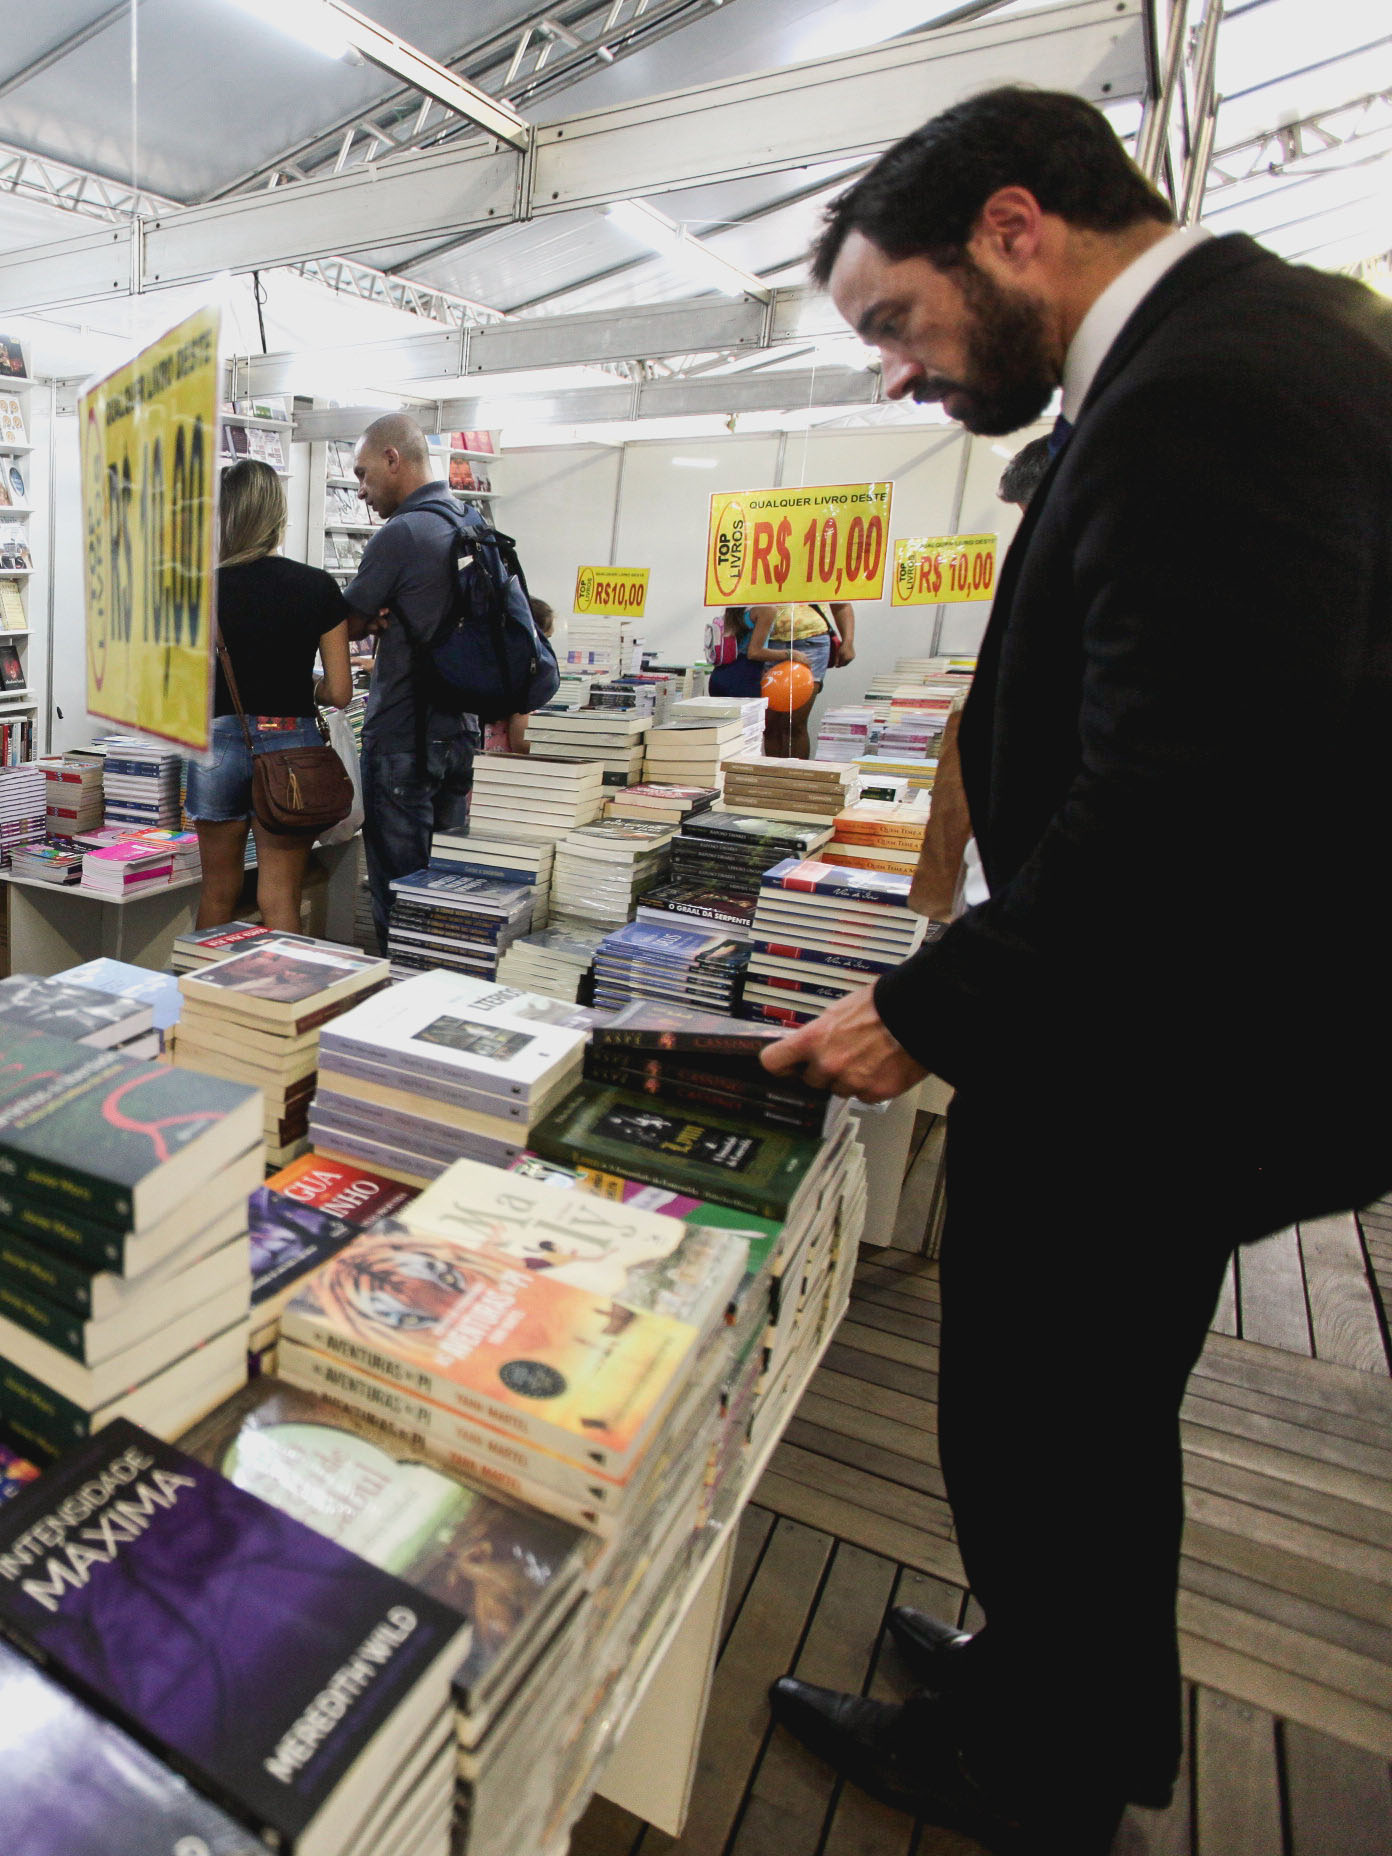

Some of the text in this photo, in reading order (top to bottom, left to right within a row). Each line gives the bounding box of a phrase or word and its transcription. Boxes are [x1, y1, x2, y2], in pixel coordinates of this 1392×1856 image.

[749, 492, 887, 509] QUALQUER LIVRO DESTE
[718, 533, 730, 566] TOP
[730, 519, 743, 578] LIVROS
[751, 515, 882, 595] R$ 10,00
[918, 552, 993, 597] R$ 10,00
[677, 905, 700, 916] GRAAL
[702, 910, 713, 918] DA
[715, 912, 751, 926] SERPENTE
[283, 1169, 343, 1201] GUA
[319, 1180, 380, 1219] INHO
[327, 1335, 403, 1380] AVENTURAS
[418, 1373, 432, 1392] PI
[325, 1367, 432, 1426] AVENTURAS PI
[22, 1469, 197, 1613] MAXIMA
[263, 1605, 419, 1786] MEREDITH WILD
